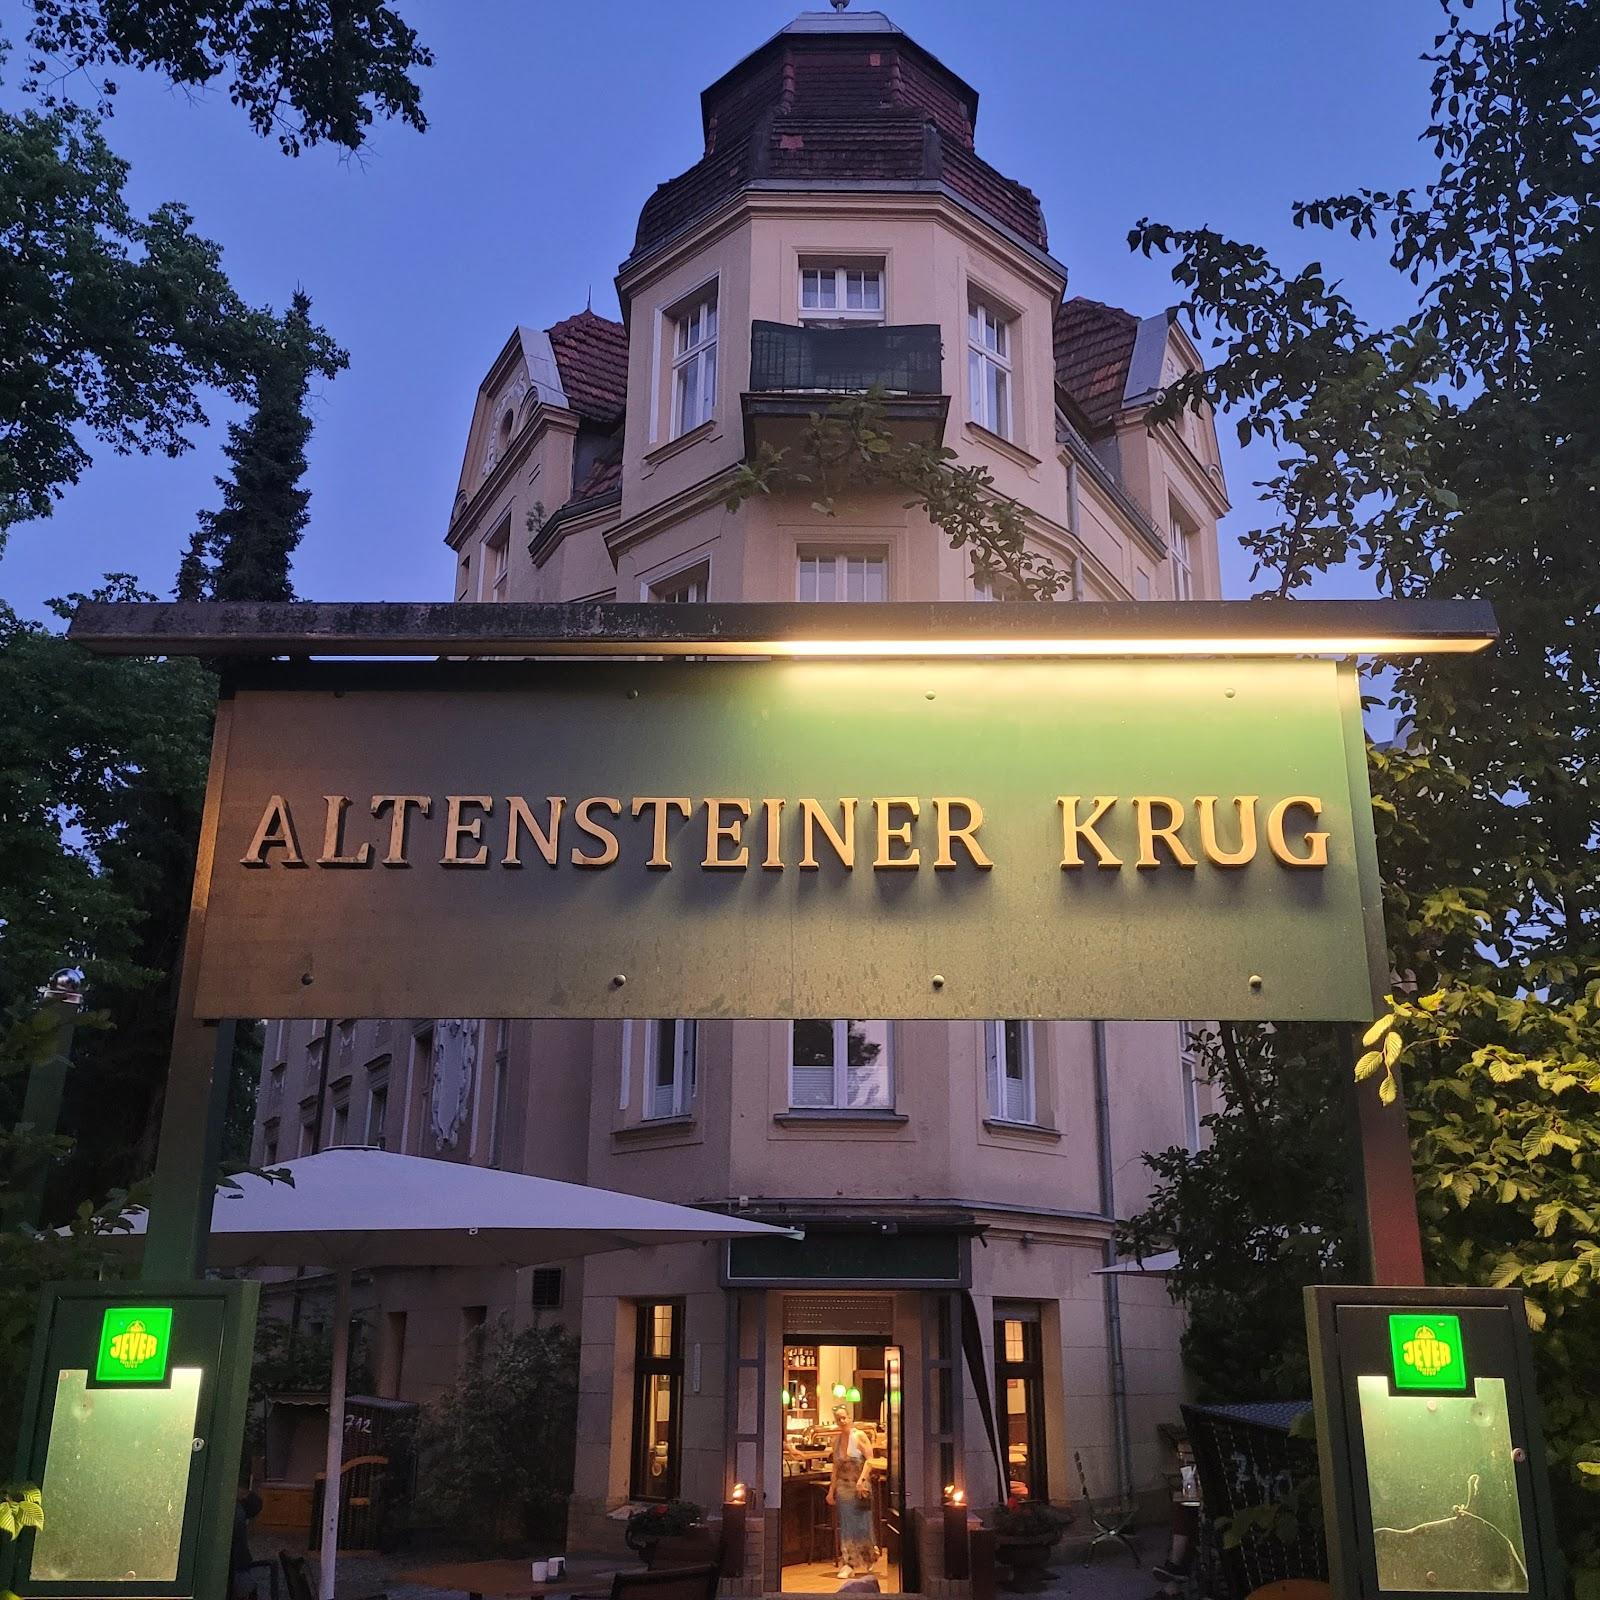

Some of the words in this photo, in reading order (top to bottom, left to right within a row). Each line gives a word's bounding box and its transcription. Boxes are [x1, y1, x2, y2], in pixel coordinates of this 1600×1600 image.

[240, 795, 993, 870] ALTENSTEINER
[1056, 795, 1331, 870] KRUG
[110, 1332, 158, 1361] JEVER
[1402, 1339, 1452, 1368] JEVER
